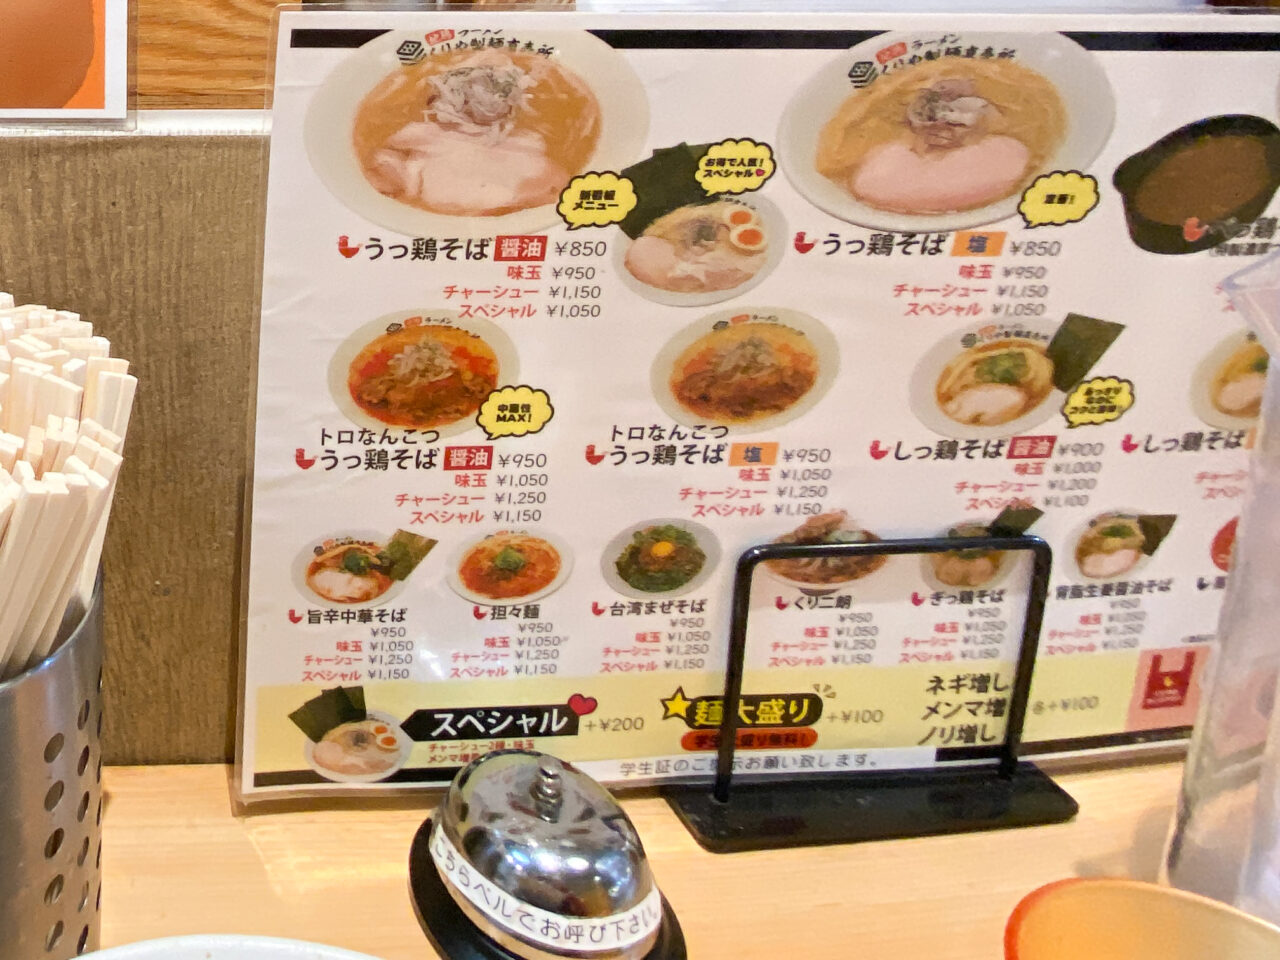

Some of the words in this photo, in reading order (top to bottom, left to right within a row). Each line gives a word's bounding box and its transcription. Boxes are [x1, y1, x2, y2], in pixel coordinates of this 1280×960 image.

[572, 201, 619, 211] メニュー
[365, 236, 493, 261] うっ鶏そば
[500, 238, 543, 258] 醤油
[554, 240, 607, 257] ¥850
[822, 233, 950, 257] うっ鶏そば
[966, 235, 989, 253] 塩
[1009, 240, 1062, 257] ¥850
[507, 264, 542, 281] 味玉
[552, 266, 596, 280] ¥950
[958, 264, 995, 280] 味玉
[1001, 266, 1048, 280] ¥950
[442, 285, 540, 300] チャーシュー
[549, 285, 602, 300] ¥1,150
[893, 283, 989, 298] チャーシュー
[458, 303, 537, 319] スペシャル
[546, 304, 601, 319] ¥1,050
[903, 302, 984, 317] スペシャル
[496, 413, 532, 423] MAX!
[320, 427, 440, 446] トロなんこつ
[610, 424, 730, 442] トロなんこつ
[610, 442, 729, 466] うっ鶏そば
[743, 446, 763, 463] 塩
[782, 448, 832, 464] ¥950
[893, 439, 1007, 461] しっ鶏そば
[320, 447, 441, 471] うっ鶏そば
[449, 449, 489, 467] 醤油
[498, 453, 548, 469] ¥950
[454, 473, 488, 489] 味玉
[496, 473, 549, 489] ¥1,050
[738, 467, 772, 482] 味玉
[780, 468, 833, 482] ¥1,050
[394, 493, 486, 508] チャーシュー
[494, 492, 547, 506] ¥1,250
[679, 487, 768, 501] チャーシュー
[776, 485, 828, 498] ¥1,250
[410, 510, 485, 525] スペシャル
[493, 510, 542, 524] ¥1,150
[691, 504, 766, 518] スペシャル
[490, 605, 541, 620] 担々麺
[610, 599, 708, 616] 台湾まぜそば
[307, 608, 408, 624] 旨辛中華そば
[669, 617, 705, 628] ¥950
[371, 627, 406, 638] ¥950
[518, 623, 553, 634] ¥950
[336, 640, 363, 652] 味玉
[370, 641, 414, 652] ¥1,050
[484, 637, 510, 649] 味玉
[602, 646, 660, 657] チャーシュー
[665, 644, 709, 655] ¥1,250
[304, 654, 363, 666] チャーシュー
[368, 654, 413, 666] ¥1,250
[451, 651, 510, 663] チャーシュー
[514, 649, 559, 660] ¥1,250
[449, 666, 508, 678] スペシャル
[514, 663, 557, 675] ¥1,150
[599, 661, 658, 673] スペシャル
[301, 669, 362, 682] スペシャル
[368, 668, 410, 680] ¥1,150
[926, 672, 1009, 695] ネギ増し
[921, 696, 1007, 720] メンマ増
[431, 708, 568, 737] スペシャル
[917, 723, 996, 746] ノリ増し
